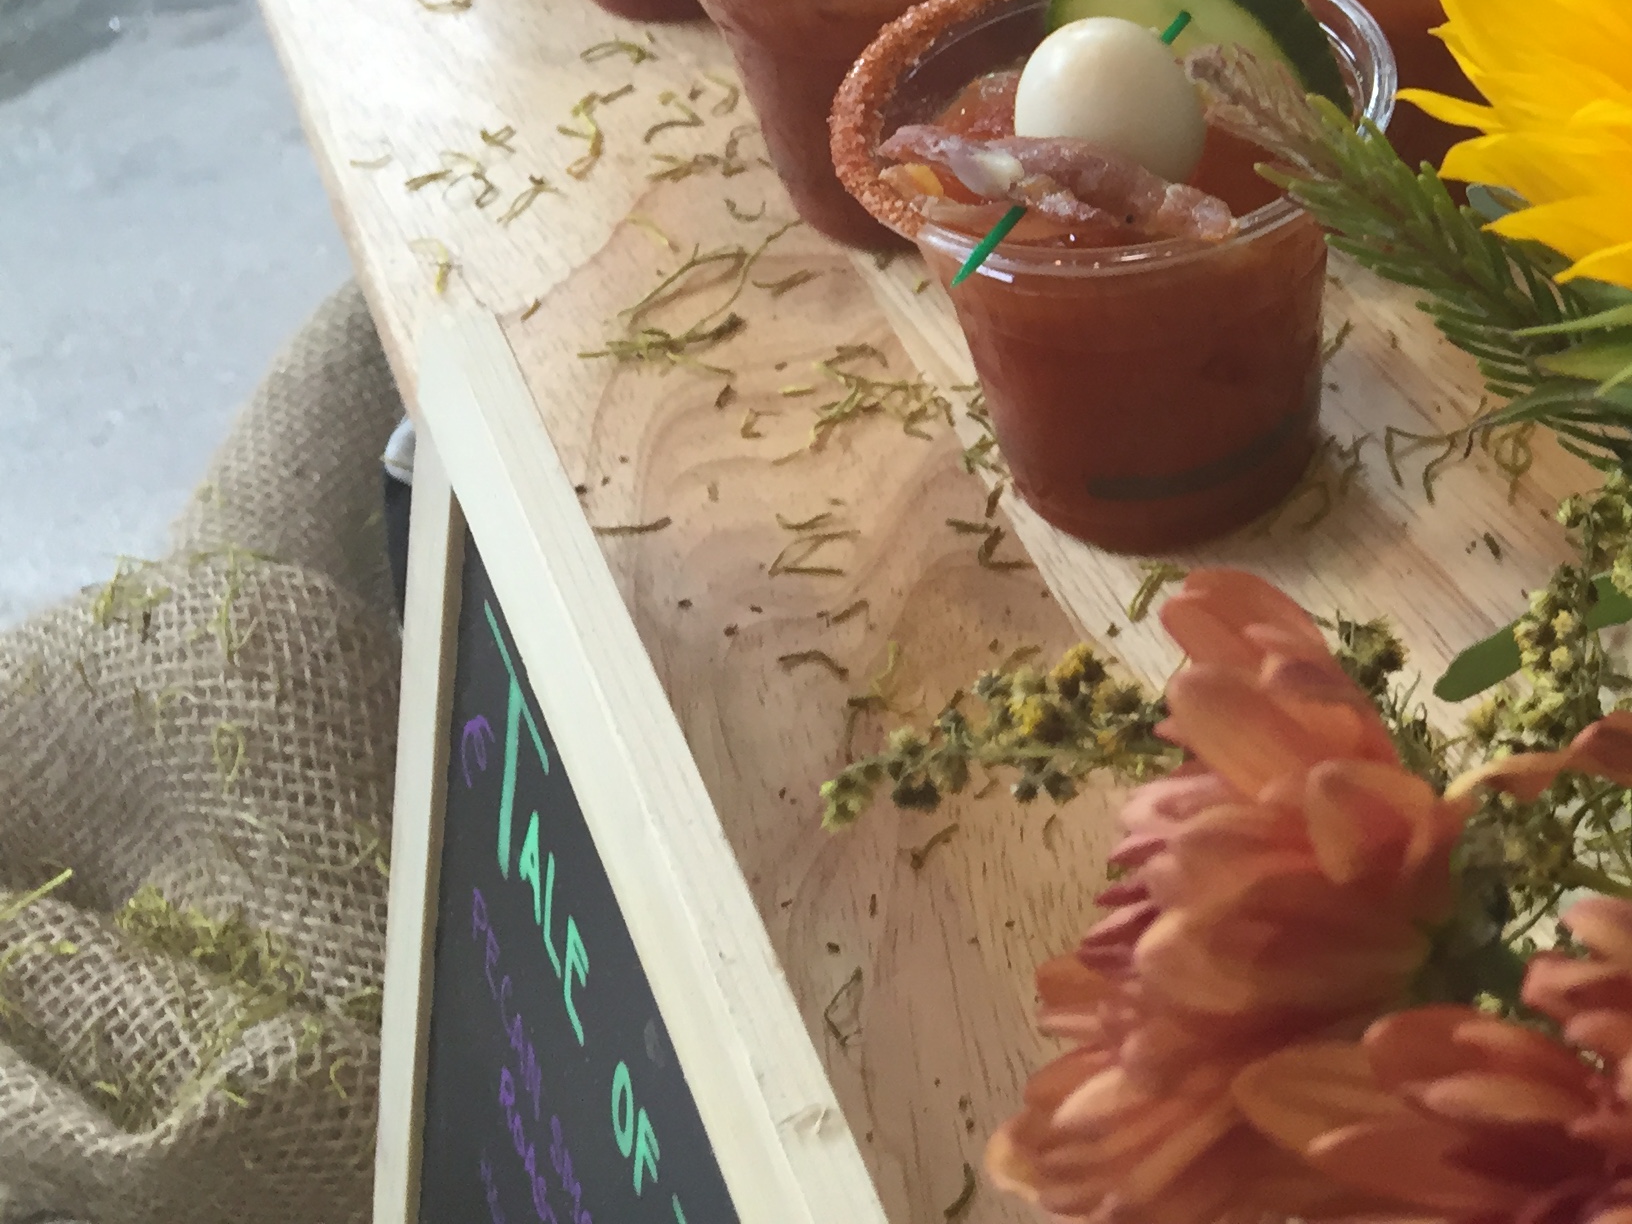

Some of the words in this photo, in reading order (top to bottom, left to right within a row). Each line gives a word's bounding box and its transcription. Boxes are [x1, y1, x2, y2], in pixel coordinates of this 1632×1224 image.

[484, 599, 589, 1047] TALE
[610, 1059, 661, 1197] OF
[499, 1066, 557, 1224] ROAS
